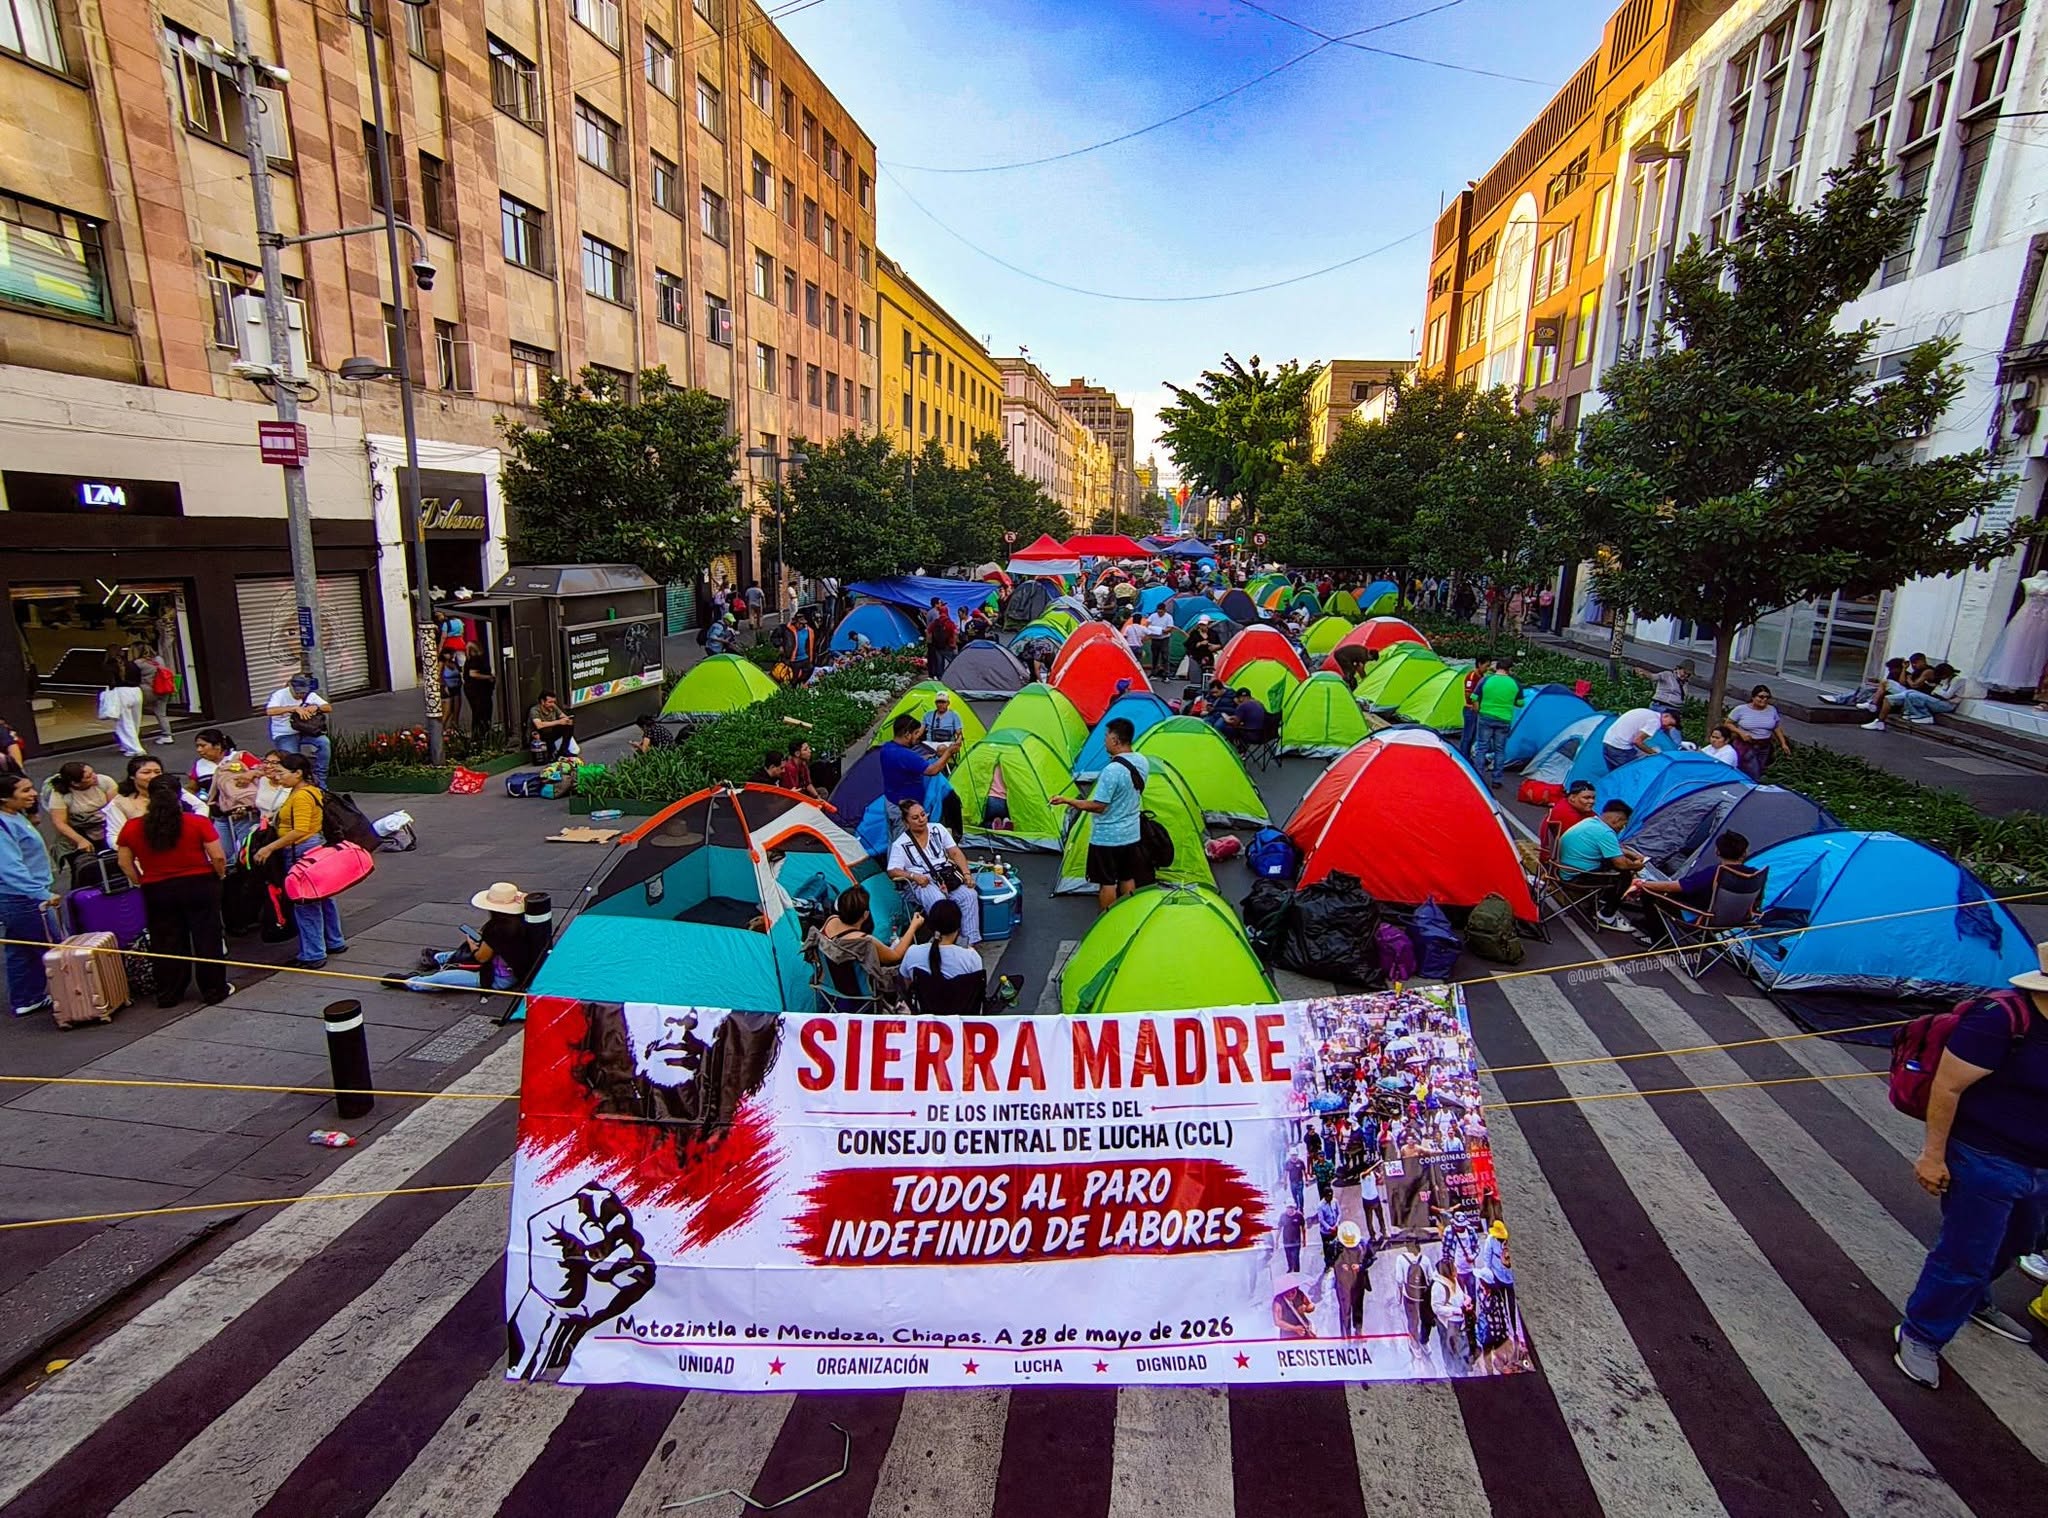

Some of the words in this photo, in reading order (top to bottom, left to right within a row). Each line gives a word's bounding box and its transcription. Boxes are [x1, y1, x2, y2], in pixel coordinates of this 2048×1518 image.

[796, 1017, 1047, 1091] SIERRA
[1072, 1014, 1292, 1090] MADRE
[927, 1104, 950, 1122] DE
[955, 1104, 987, 1122] LOS
[993, 1102, 1106, 1122] INTEGRANTES
[1112, 1100, 1143, 1118] DEL
[837, 1129, 946, 1155] CONSEJO
[954, 1128, 1057, 1154] CENTRAL
[1062, 1127, 1092, 1152] DE
[1099, 1123, 1169, 1150] LUCHA
[1175, 1119, 1233, 1148] (CCL)
[1440, 1163, 1456, 1172] CCL
[892, 1173, 1010, 1214] TODOS
[1021, 1172, 1067, 1211] AL
[1082, 1167, 1172, 1208] PARO
[824, 1216, 1033, 1258] INDEFINIDO
[1042, 1214, 1091, 1252] DE
[1098, 1206, 1243, 1249] LABORES
[615, 1314, 737, 1338] Motozintla
[744, 1323, 770, 1338] de
[777, 1324, 885, 1343] Mendoza,
[892, 1328, 987, 1348] Chiapas.
[995, 1328, 1013, 1344] A
[1020, 1328, 1047, 1346] 28
[1054, 1324, 1078, 1343] de
[1085, 1325, 1142, 1349] mayo
[1149, 1321, 1172, 1341] de
[1180, 1316, 1234, 1340] 2026
[678, 1354, 735, 1375] UNIDAD
[816, 1354, 929, 1375] ORGANIZACIÓN
[1014, 1358, 1064, 1373] LUCHA
[1136, 1354, 1208, 1372] DIGNIDAD
[1277, 1348, 1373, 1368] RESISTENCIA
